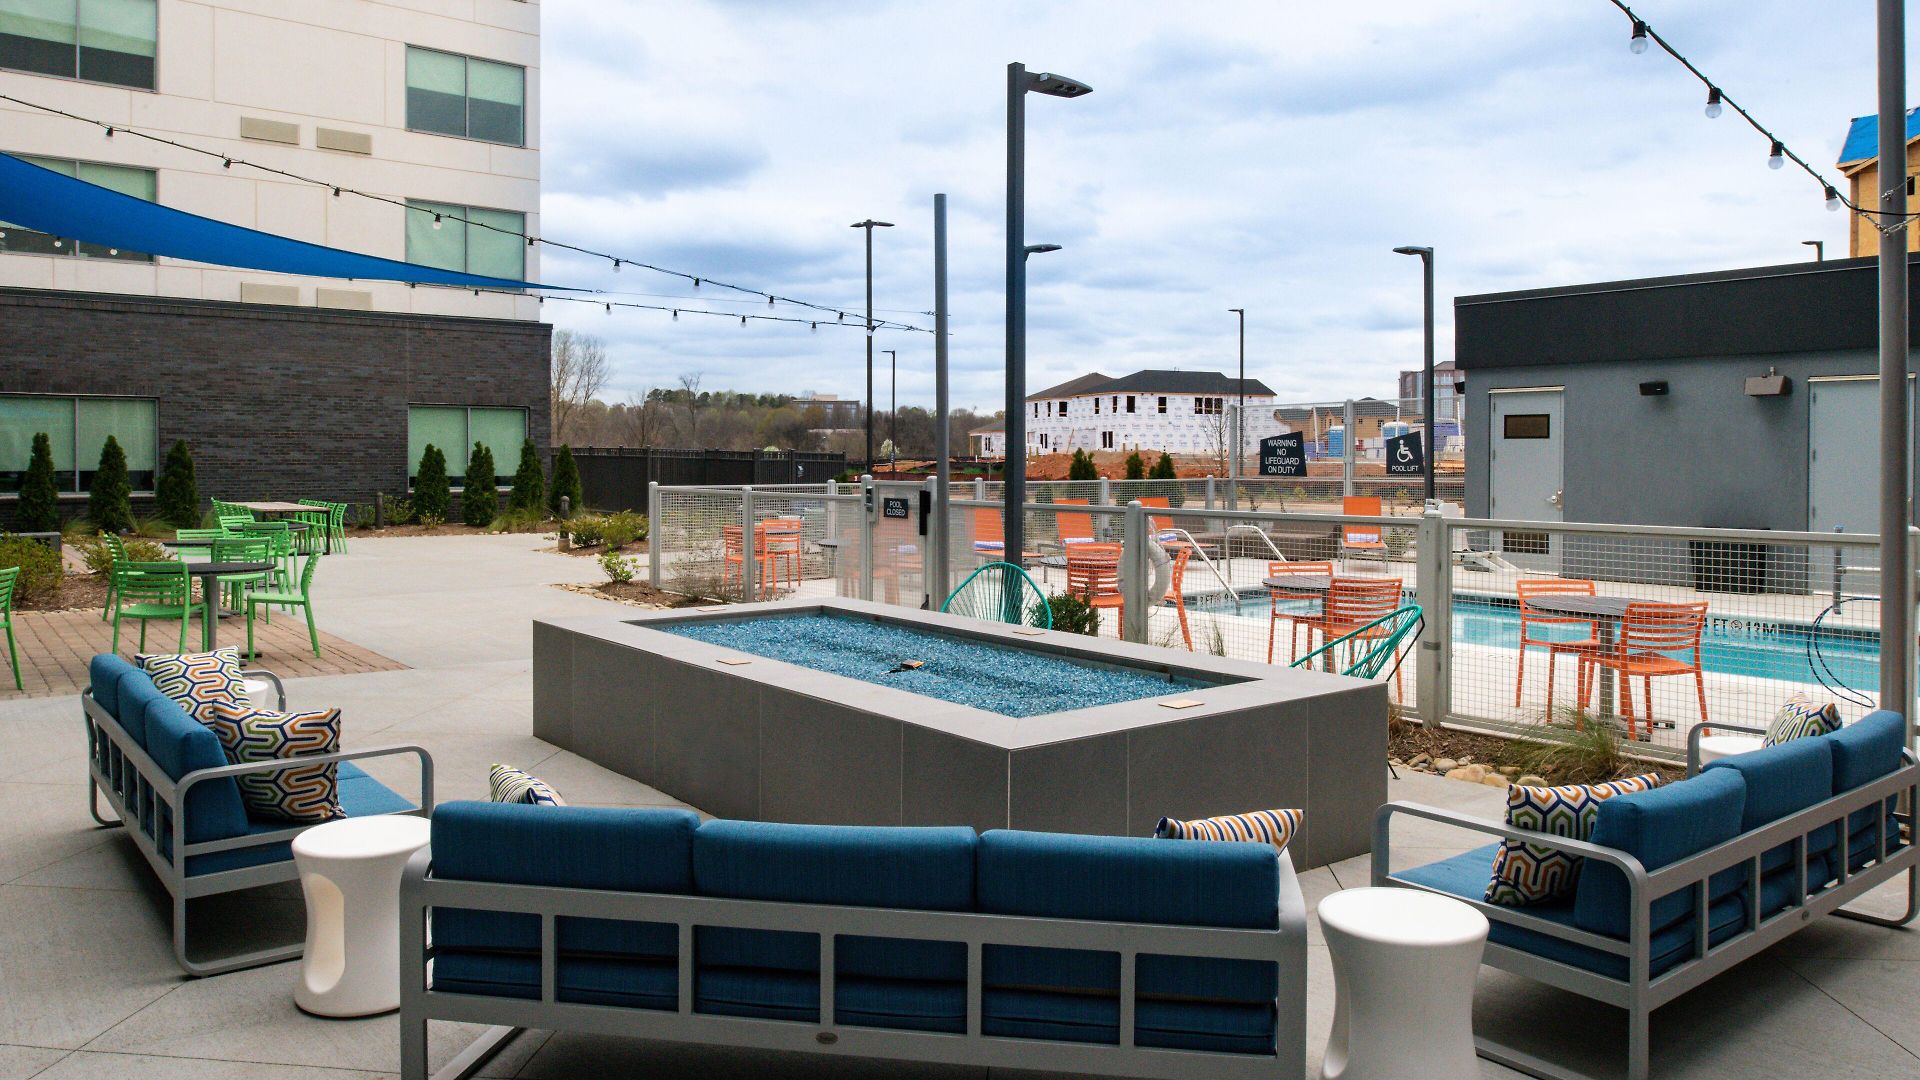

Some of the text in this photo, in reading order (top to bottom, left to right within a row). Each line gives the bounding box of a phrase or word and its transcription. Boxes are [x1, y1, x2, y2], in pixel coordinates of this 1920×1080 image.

[1267, 439, 1297, 447] WARNING
[1276, 448, 1287, 456] NO
[1265, 456, 1300, 465] LIFEGUARD
[1267, 465, 1296, 474] ON DUTY
[889, 500, 903, 509] POOL
[886, 508, 906, 517] CLOSED
[1713, 618, 1729, 630] FT
